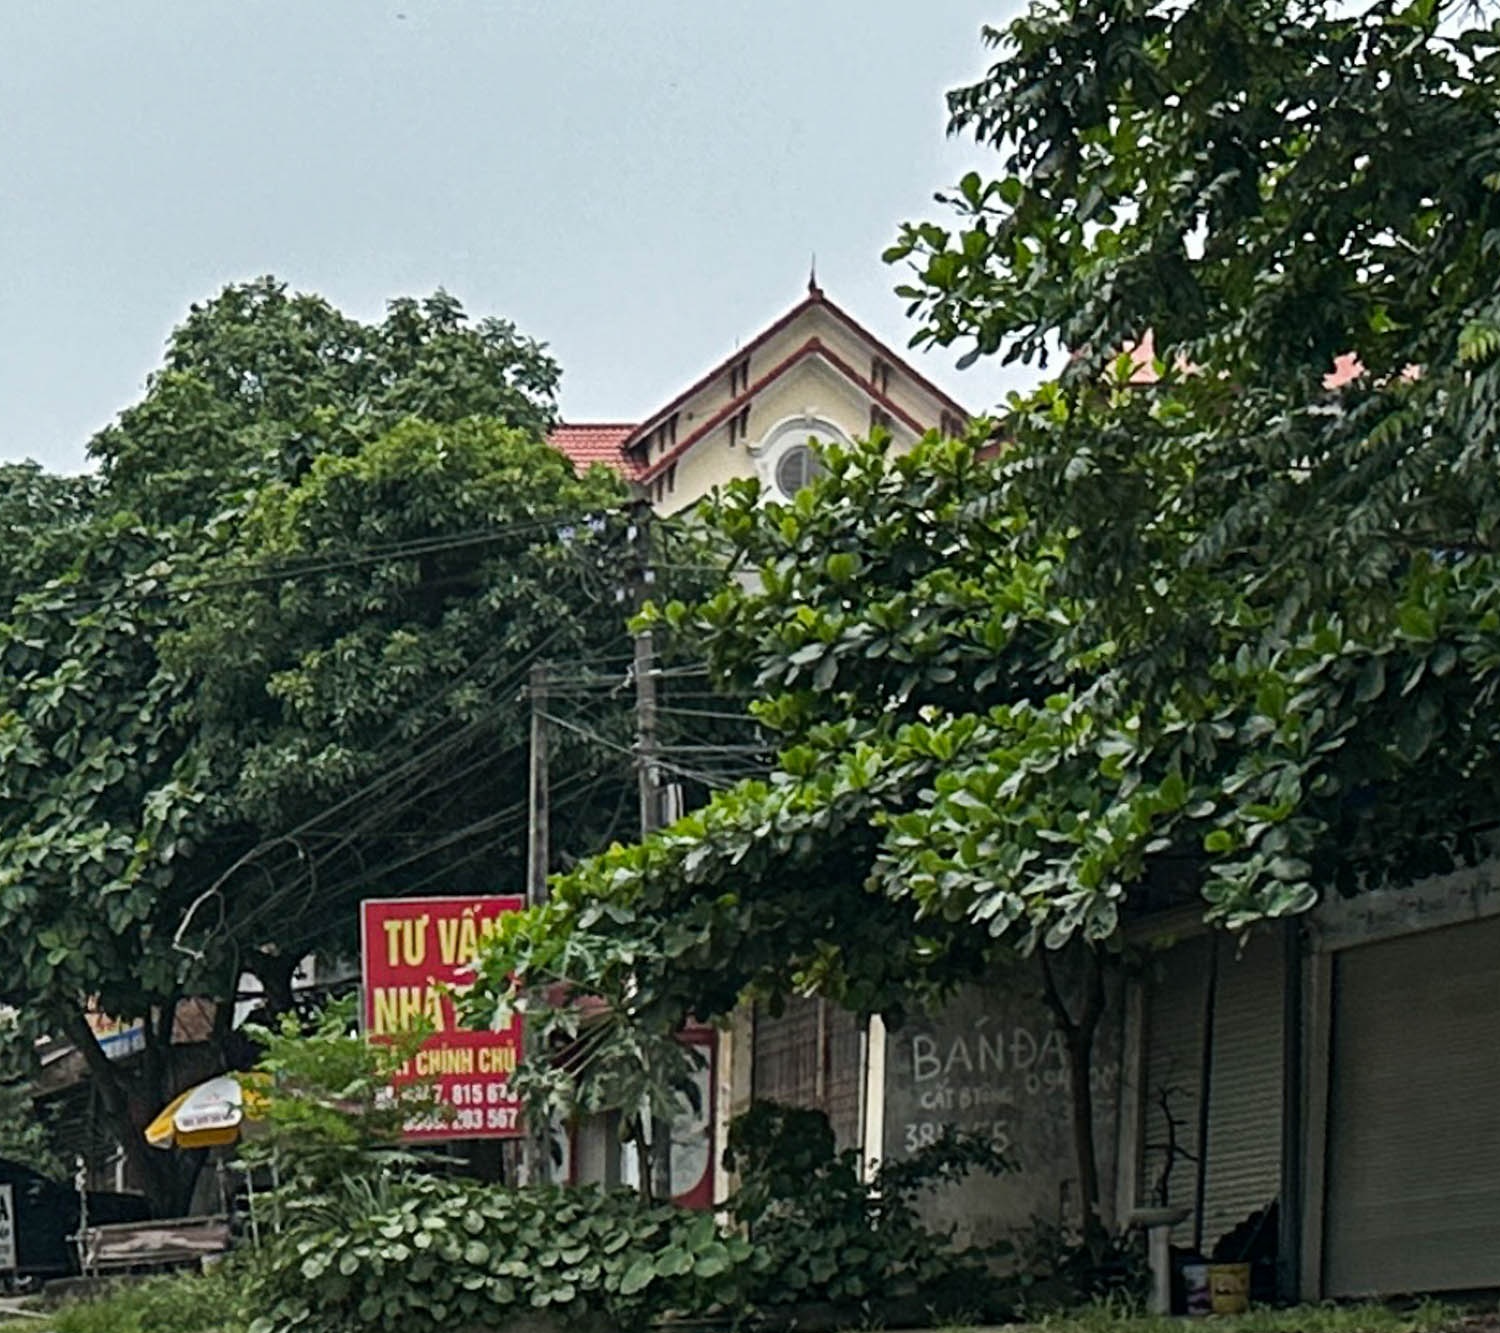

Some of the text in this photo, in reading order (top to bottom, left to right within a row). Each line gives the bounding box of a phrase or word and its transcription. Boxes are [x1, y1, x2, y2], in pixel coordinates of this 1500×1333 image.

[383, 913, 430, 967] TƯ
[415, 1042, 475, 1076] CHÍNH
[478, 1039, 517, 1075] CHỦ
